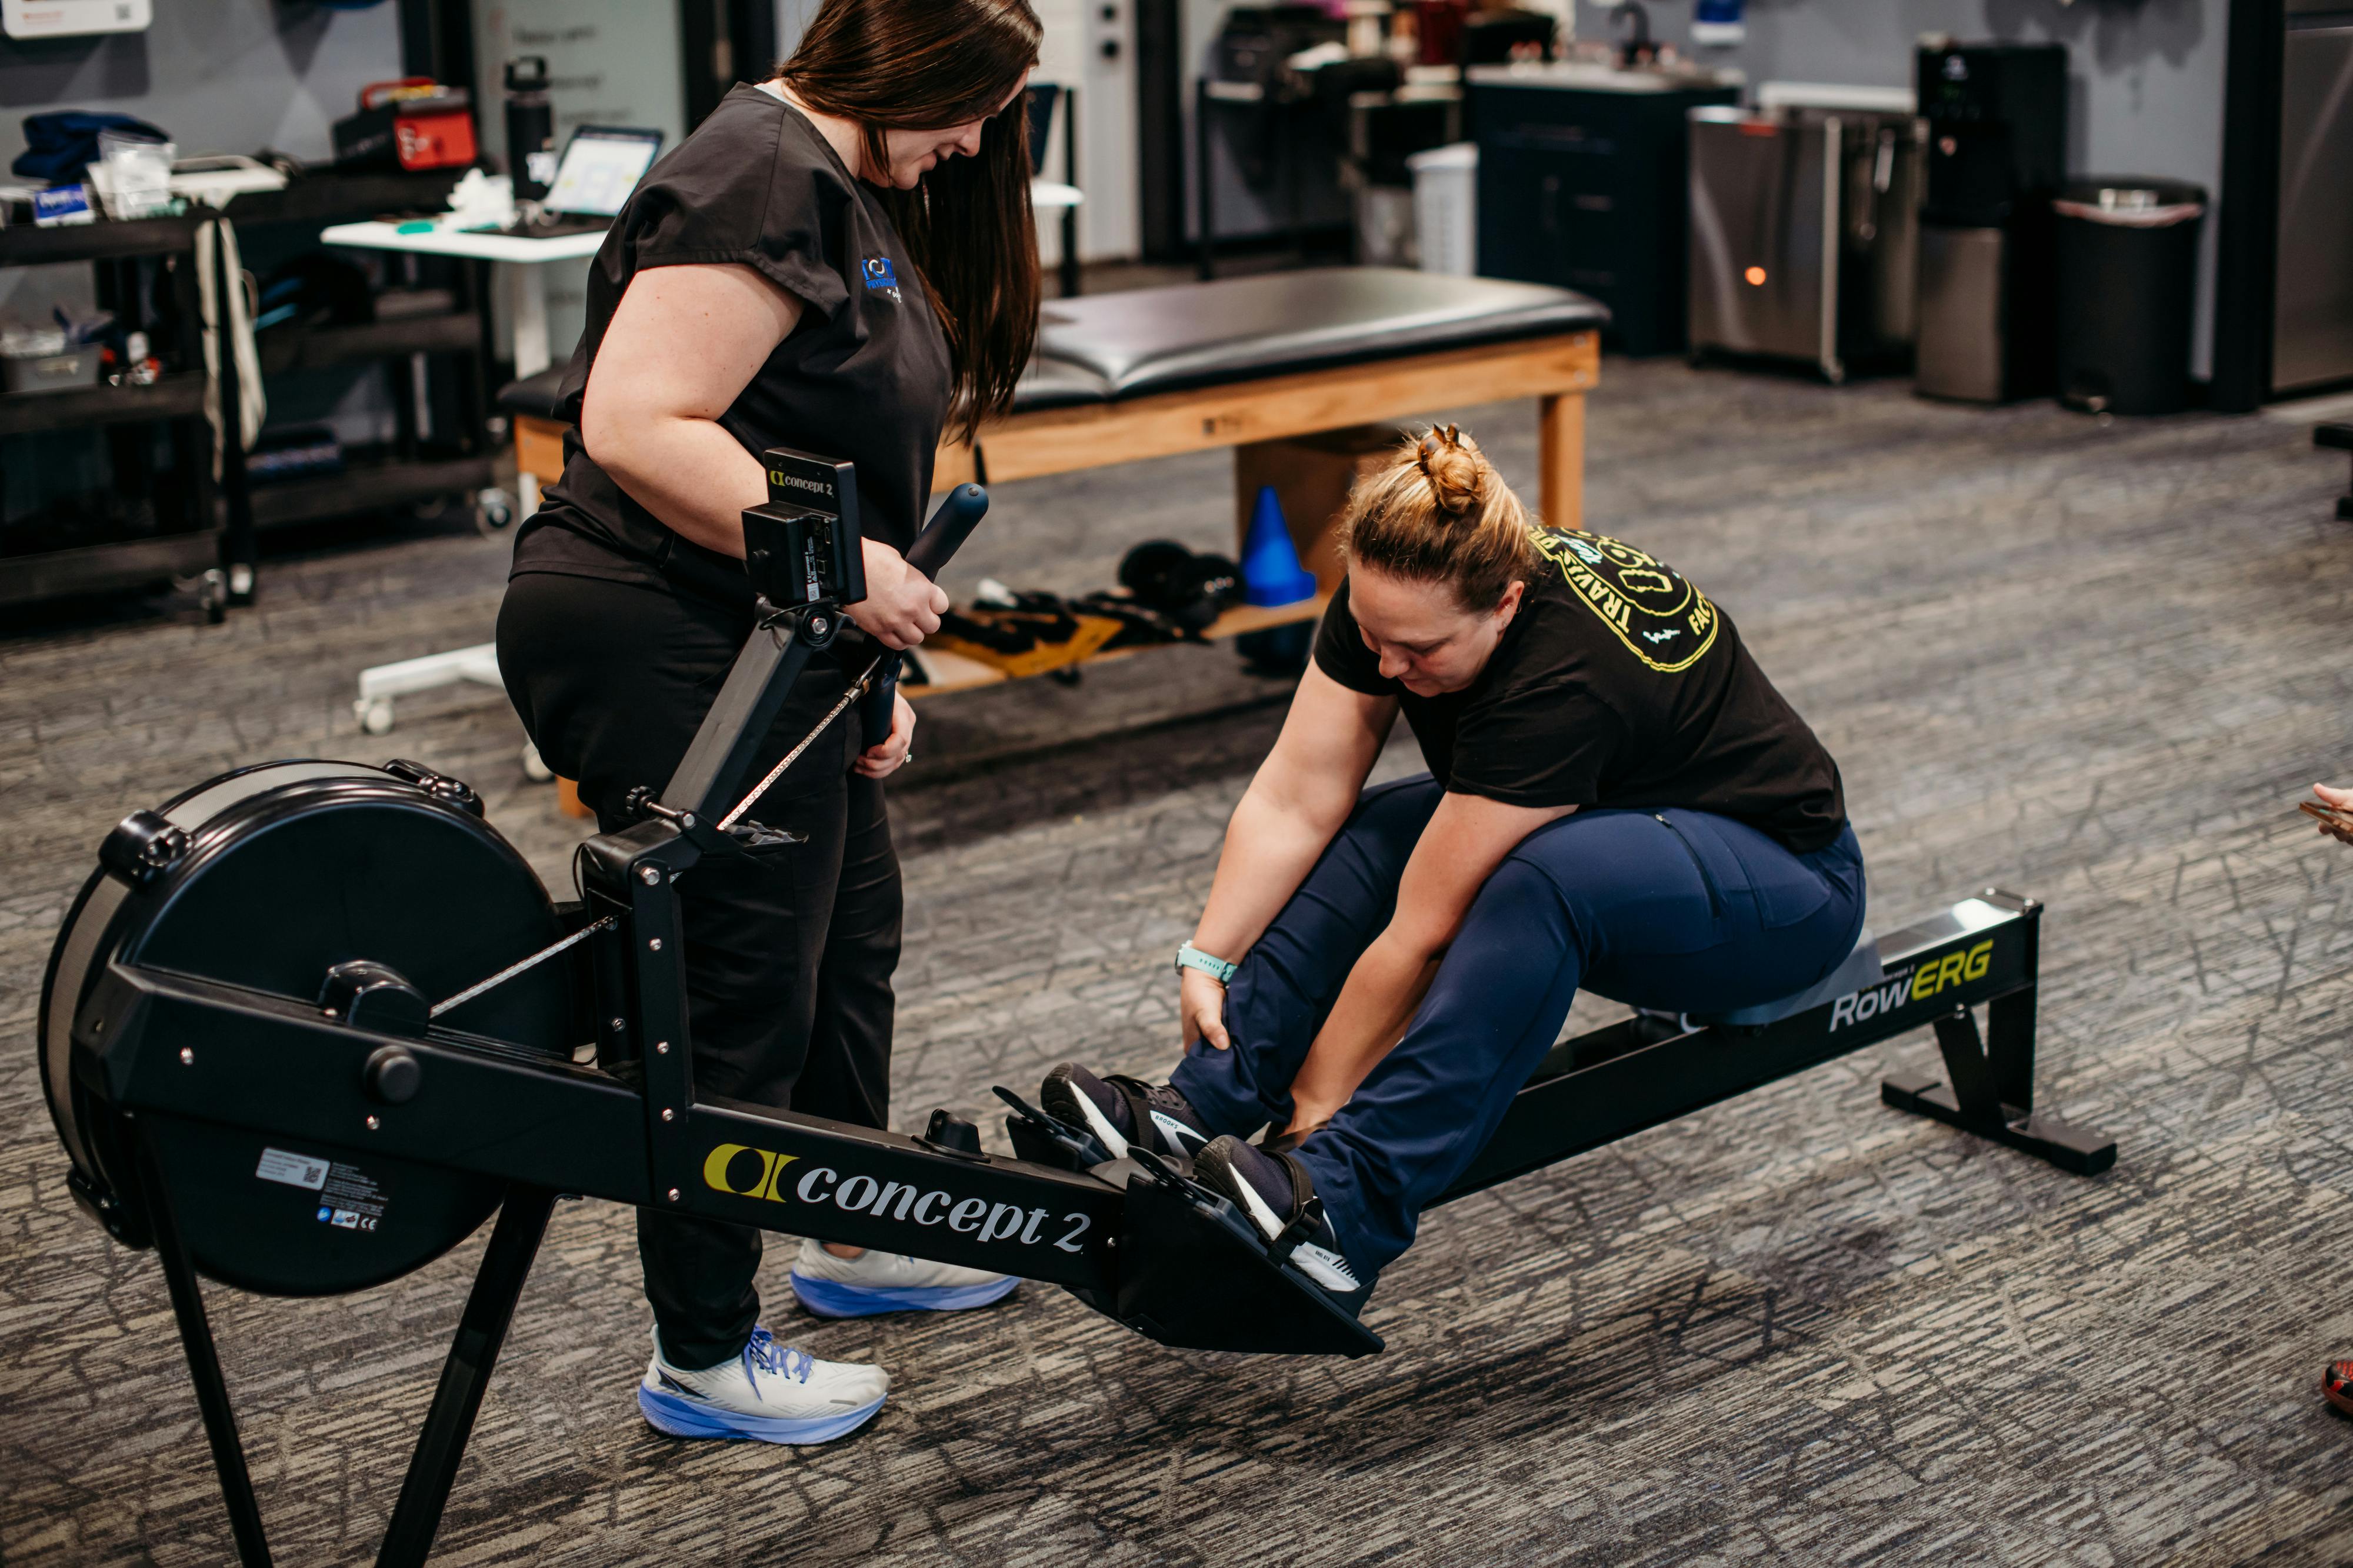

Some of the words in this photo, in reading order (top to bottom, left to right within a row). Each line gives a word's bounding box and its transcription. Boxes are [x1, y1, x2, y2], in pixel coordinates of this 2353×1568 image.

[785, 476, 824, 493] concept
[826, 483, 833, 496] 2
[1155, 1115, 1179, 1129] BROOKS
[796, 1167, 1050, 1245] concept
[1052, 1212, 1091, 1253] 2
